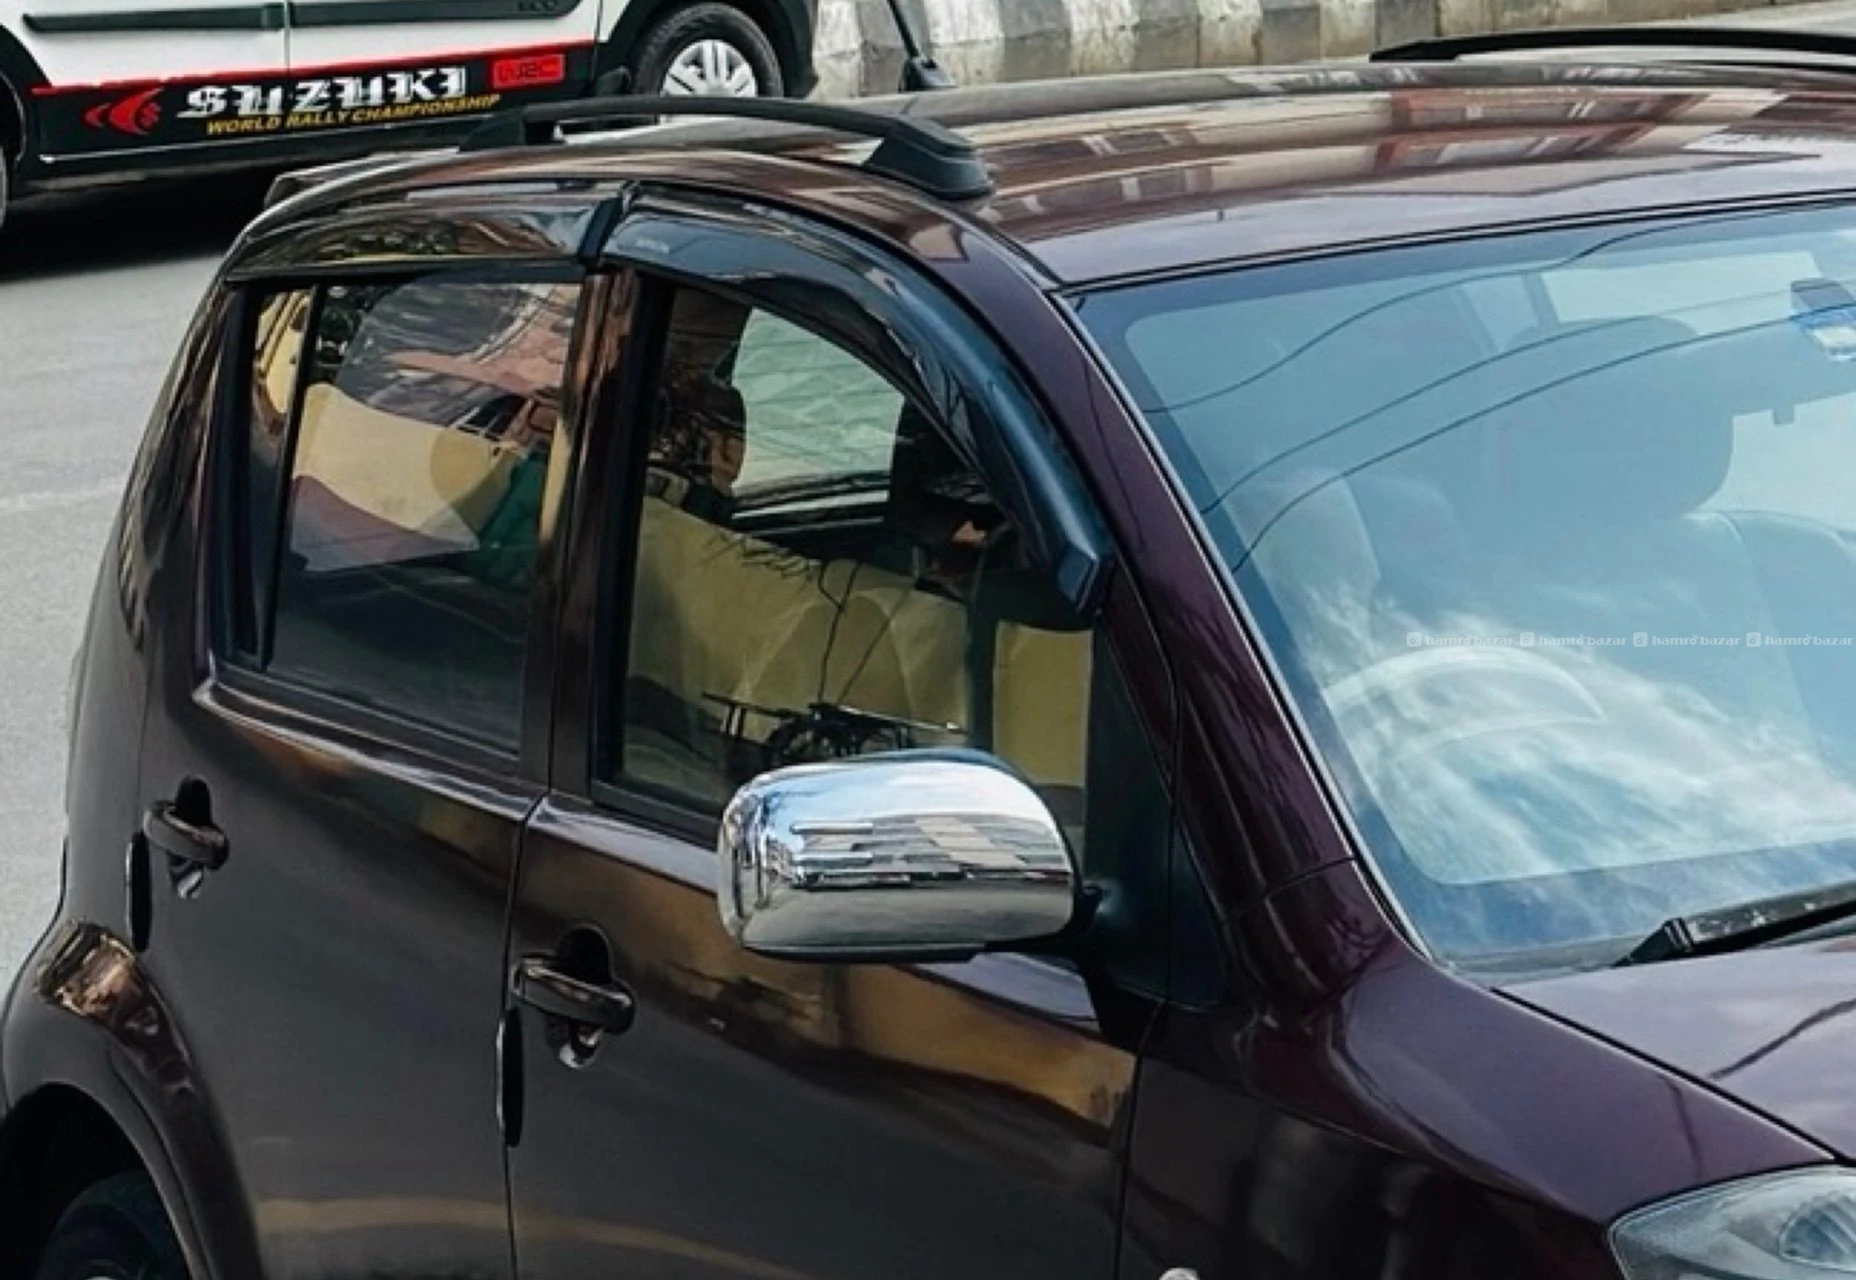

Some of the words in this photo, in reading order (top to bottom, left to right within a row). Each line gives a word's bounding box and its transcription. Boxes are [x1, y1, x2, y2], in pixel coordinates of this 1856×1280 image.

[177, 65, 467, 119] SUZUKI
[207, 116, 282, 135] WORLD
[286, 110, 349, 128] RALLY
[352, 93, 501, 122] CHAMPIONSHIP
